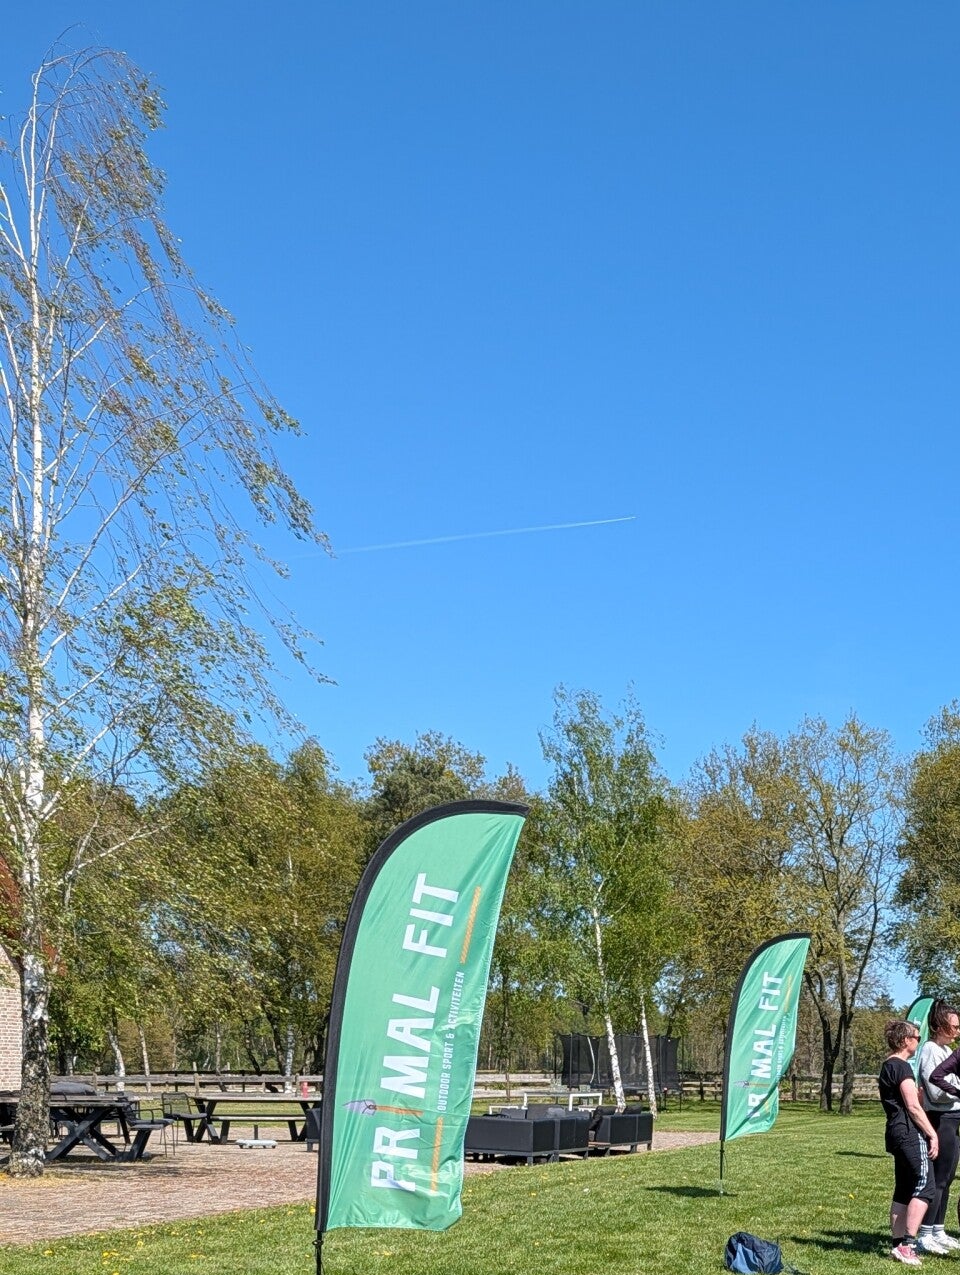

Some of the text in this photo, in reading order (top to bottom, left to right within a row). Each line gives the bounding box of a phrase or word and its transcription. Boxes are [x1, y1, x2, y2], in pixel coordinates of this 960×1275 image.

[402, 873, 459, 958] FIT
[758, 972, 783, 1011] FIT
[443, 1041, 454, 1070] SPORT
[446, 1032, 455, 1040] &
[437, 1072, 451, 1112] OUTDOOR
